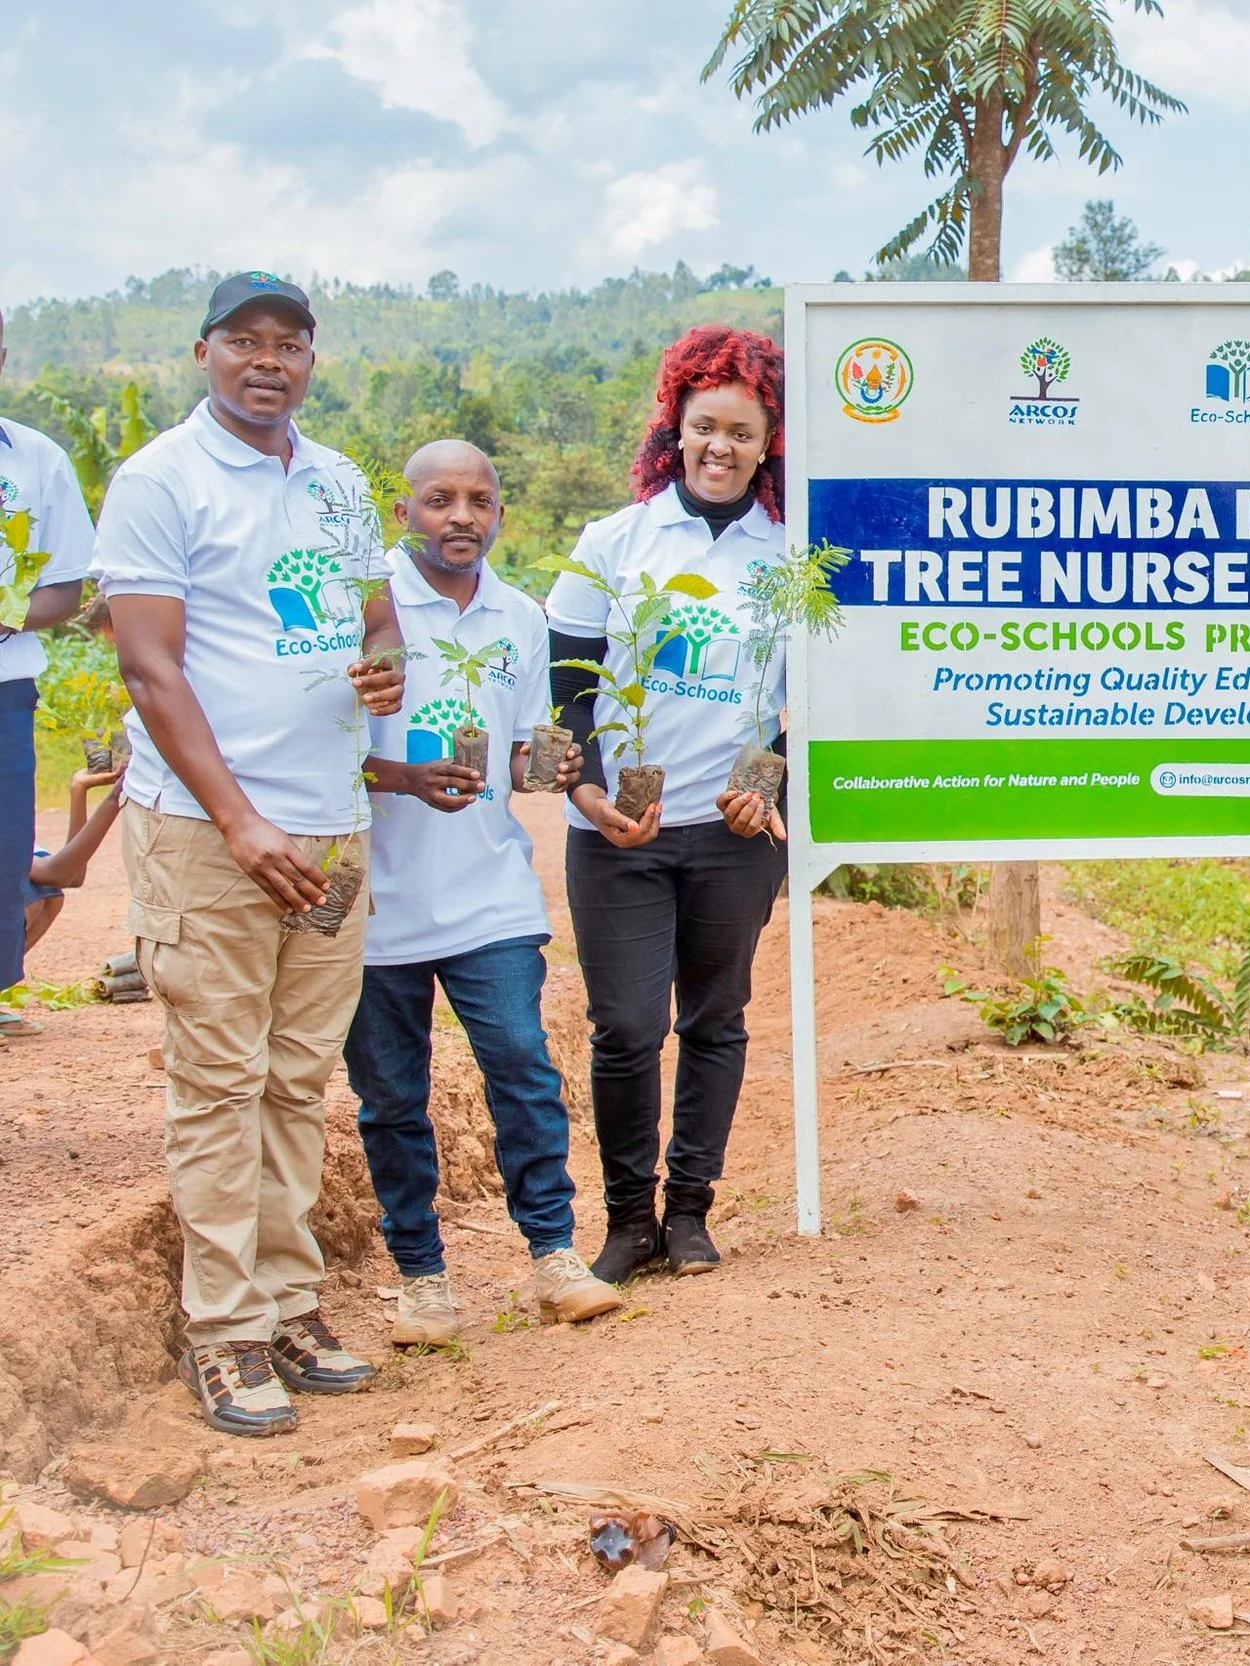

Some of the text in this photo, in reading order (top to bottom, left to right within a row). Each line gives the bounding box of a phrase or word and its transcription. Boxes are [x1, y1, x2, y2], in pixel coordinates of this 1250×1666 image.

[1009, 404, 1078, 418] ARCOS
[928, 486, 1220, 539] RUBIMBA
[860, 550, 1022, 601] TREE
[900, 621, 1186, 651] ECO-SCHOOLS
[641, 675, 742, 704] Eco-Schools
[933, 667, 1091, 697] Promoting
[1100, 666, 1207, 696] Quality
[986, 702, 1155, 726] Sustainable
[833, 773, 1141, 790] Collaborative Action for Nature and People
